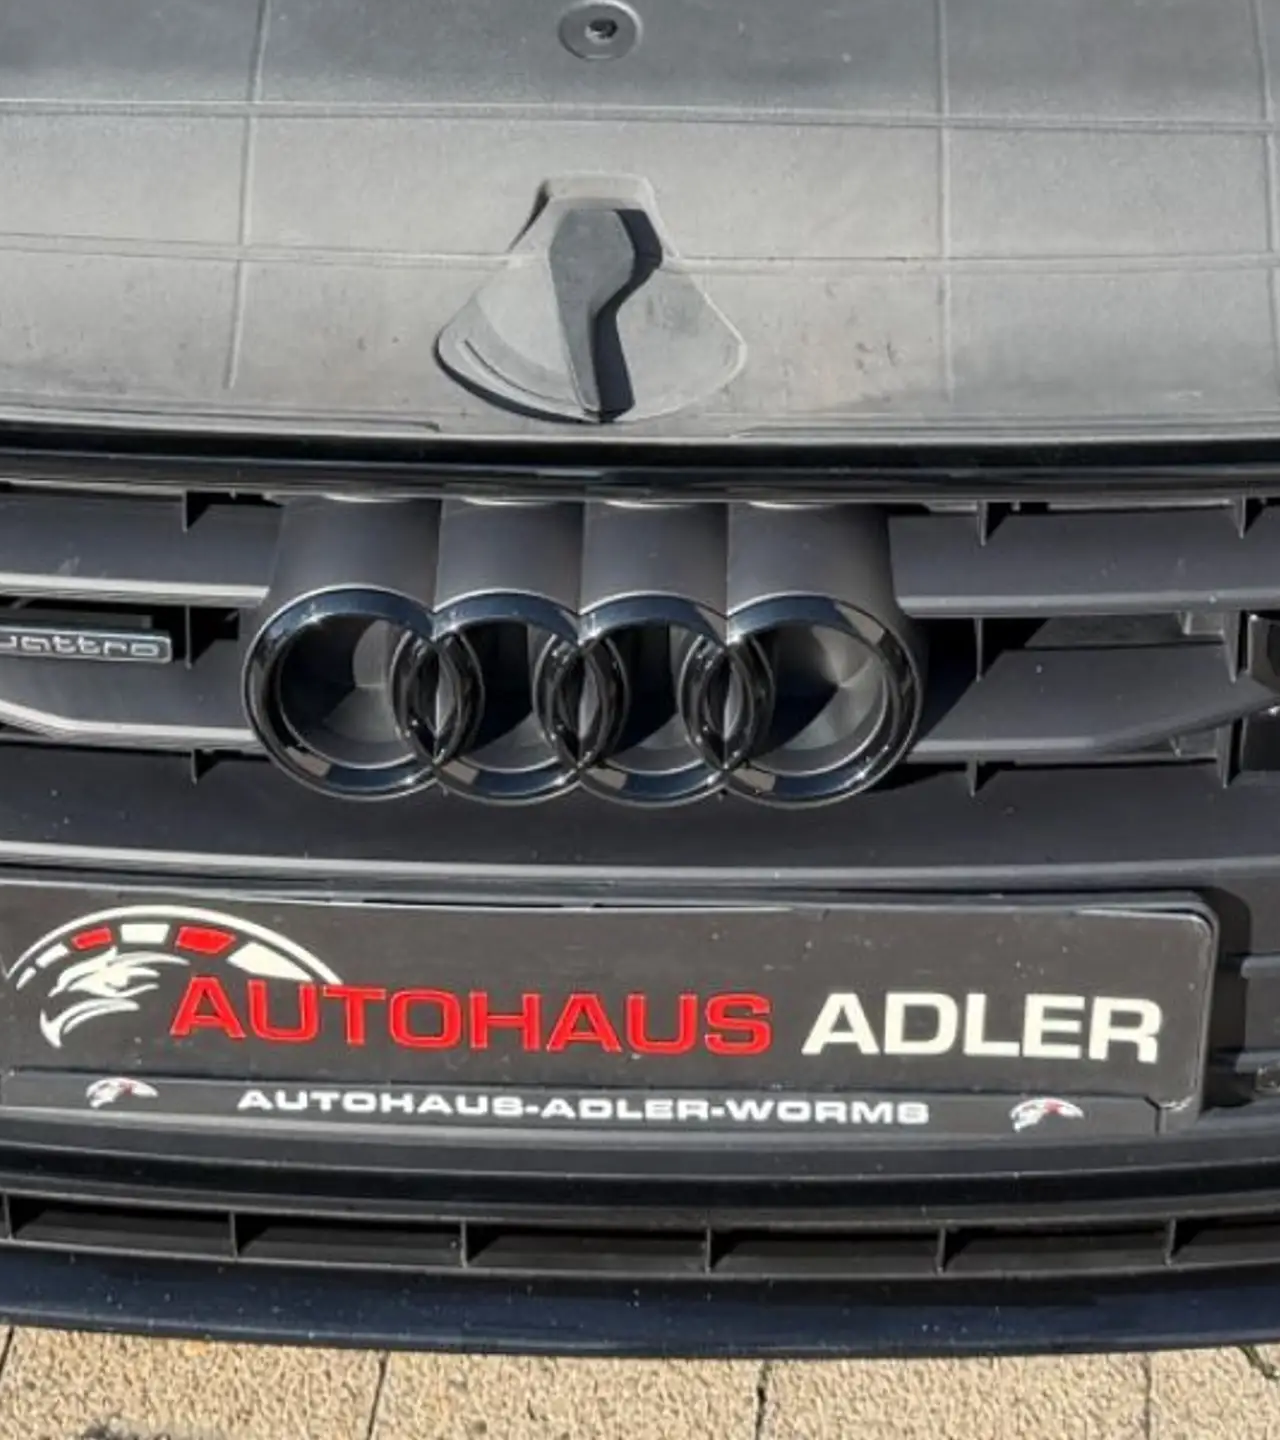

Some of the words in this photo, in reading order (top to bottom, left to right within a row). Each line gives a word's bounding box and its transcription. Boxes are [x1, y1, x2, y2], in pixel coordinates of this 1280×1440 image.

[170, 975, 774, 1056] AUTOHAUS
[801, 991, 1164, 1064] ADLER
[236, 1088, 931, 1126] AUTOHAUS-ADLER-WORMS
